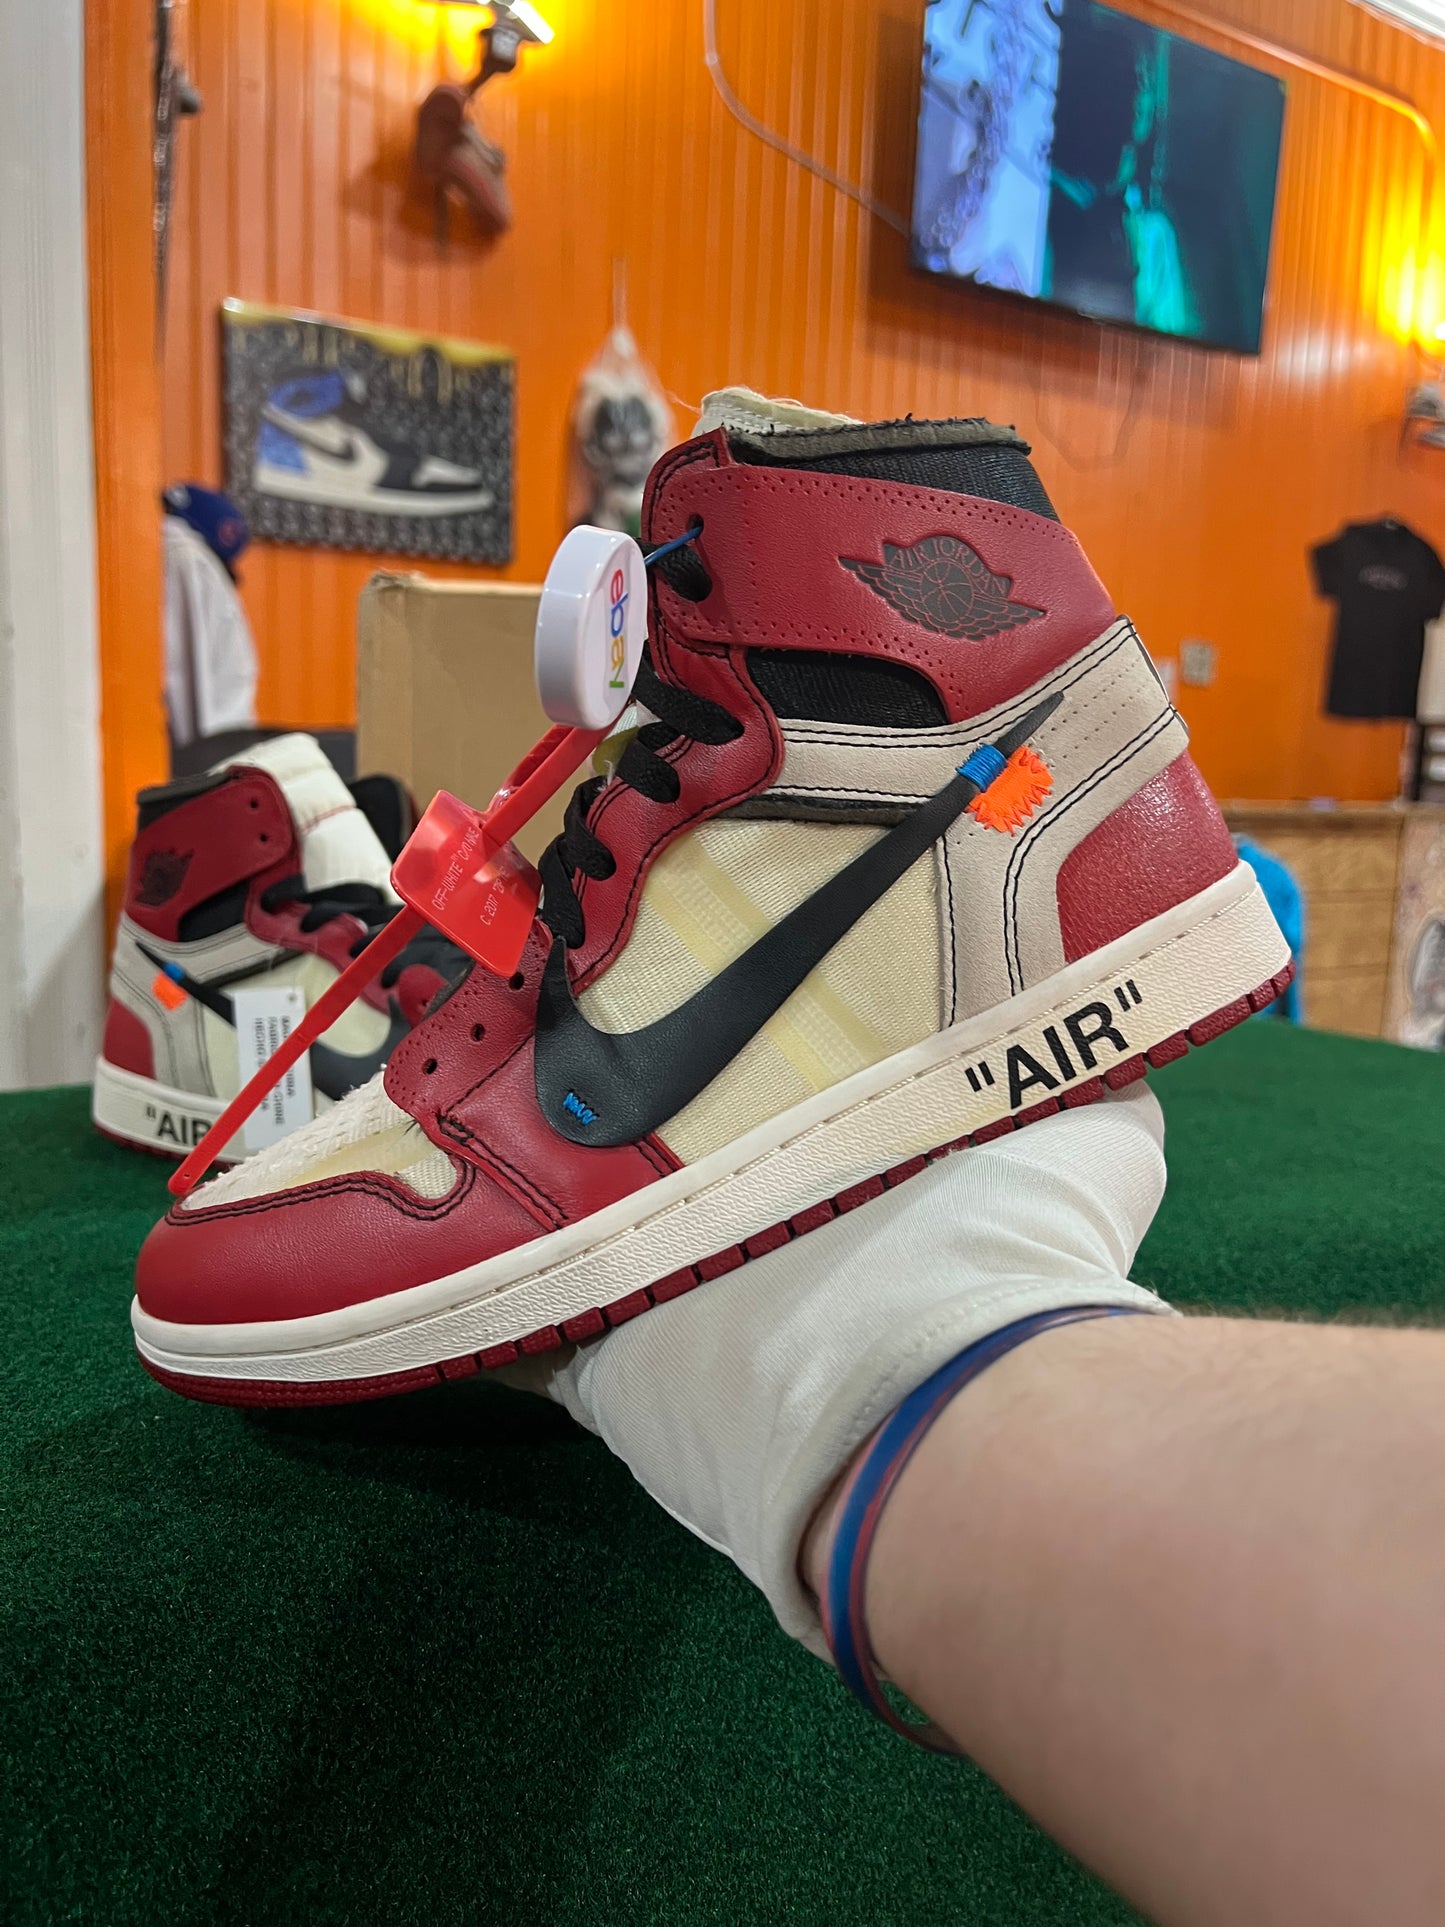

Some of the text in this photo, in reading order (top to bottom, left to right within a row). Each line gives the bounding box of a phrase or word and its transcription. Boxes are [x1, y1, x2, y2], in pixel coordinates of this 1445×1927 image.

[891, 538, 1007, 596] AIR JORDAN
[609, 568, 629, 689] ebay
[964, 978, 1143, 1110] "AIR"
